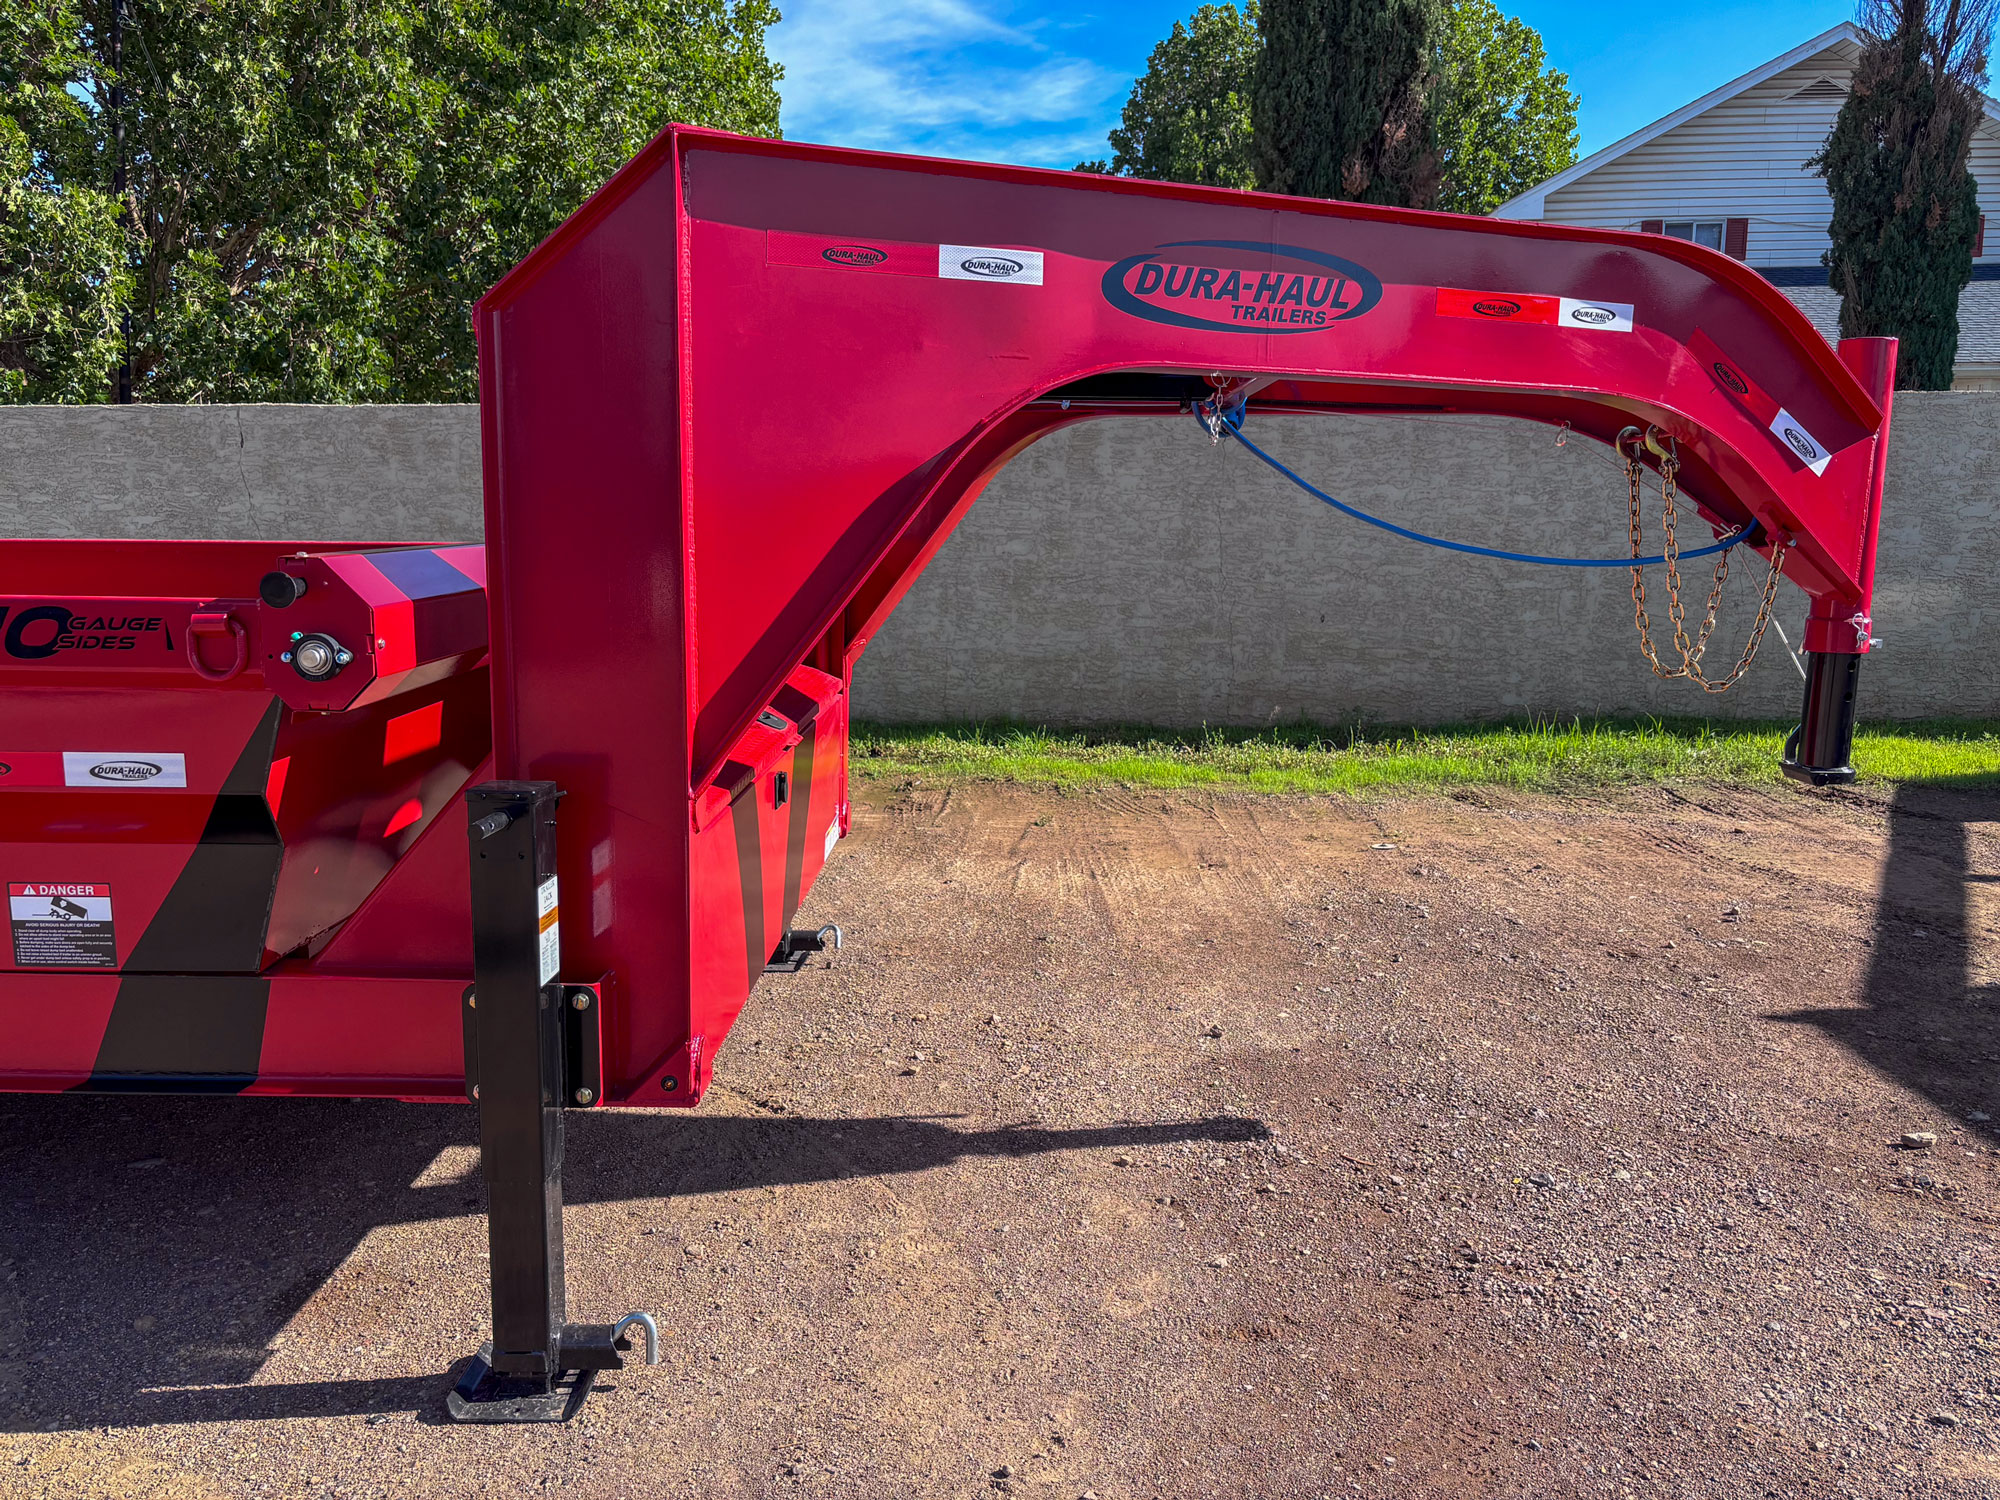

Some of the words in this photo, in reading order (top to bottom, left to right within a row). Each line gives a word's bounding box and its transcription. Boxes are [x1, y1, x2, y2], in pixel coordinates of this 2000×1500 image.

[829, 250, 880, 263] DURA-HAUL
[968, 261, 1017, 273] DURA-HAUL
[1134, 263, 1350, 309] DURA-HAUL
[1231, 304, 1327, 325] TRAILERS
[1478, 303, 1514, 313] DURA-HAUL
[1577, 310, 1610, 320] DURA-HAUL
[1787, 429, 1813, 457] DURA-HAUL
[68, 617, 163, 631] GAUGE
[56, 635, 136, 649] SIDES
[97, 766, 154, 775] DURA-HAUL
[39, 885, 94, 895] DANGER
